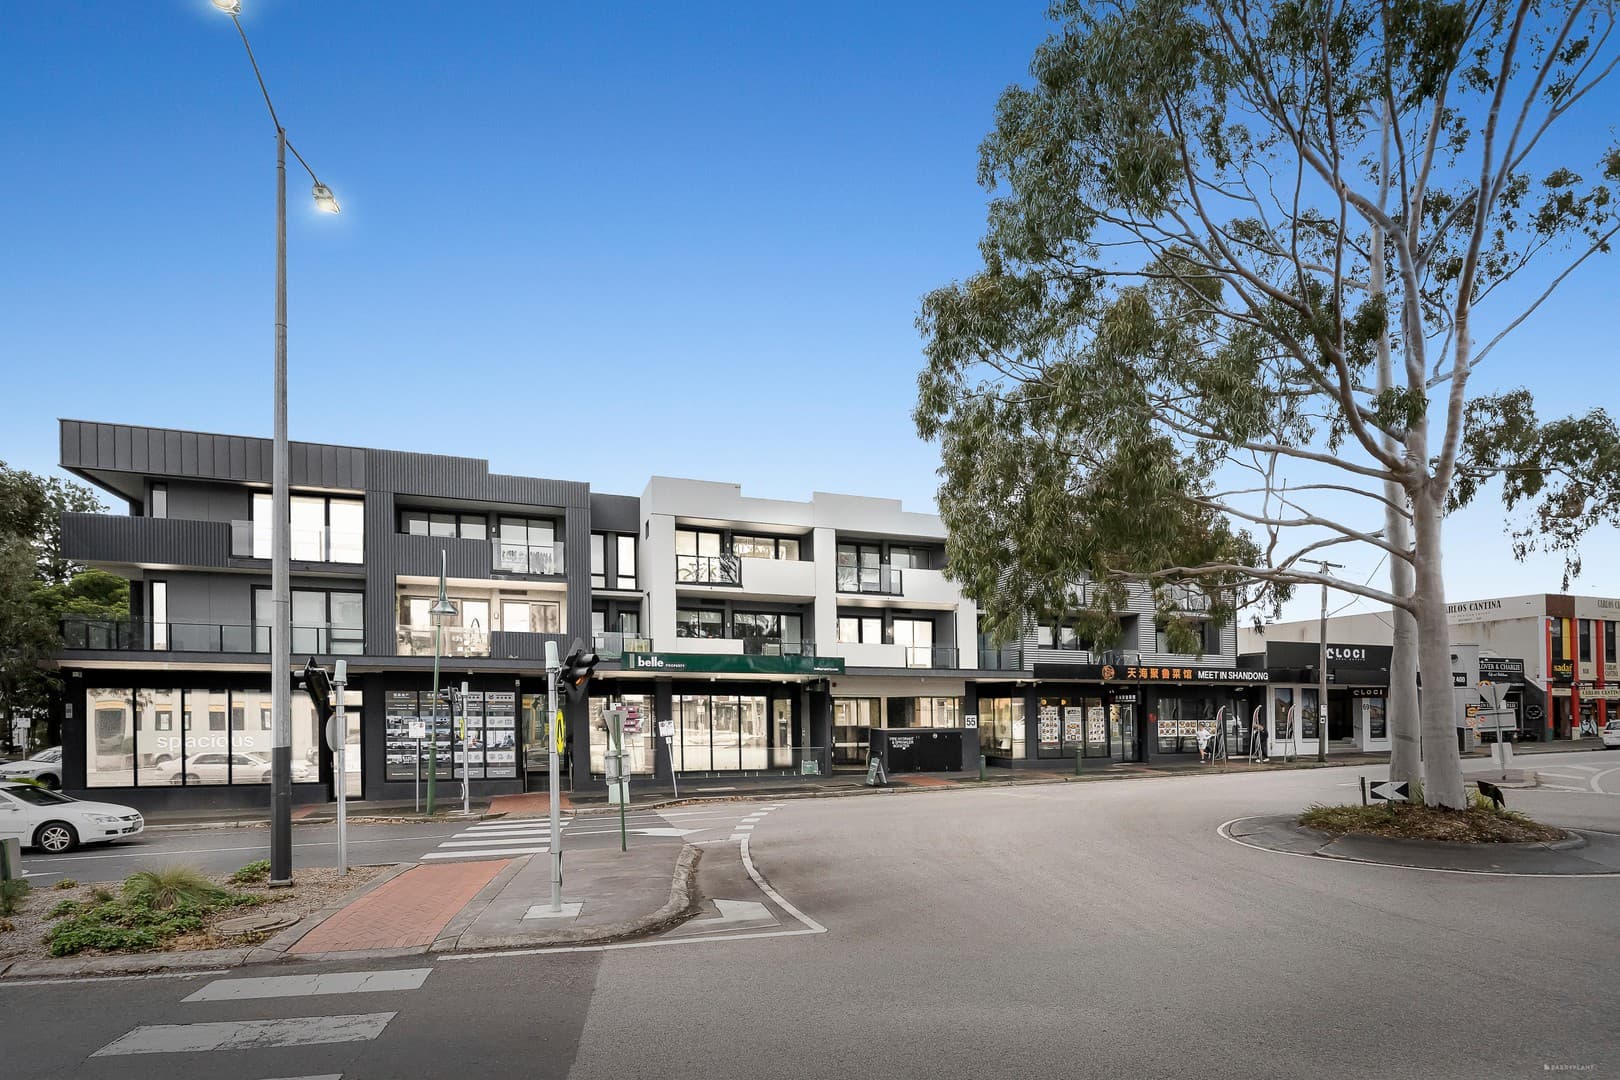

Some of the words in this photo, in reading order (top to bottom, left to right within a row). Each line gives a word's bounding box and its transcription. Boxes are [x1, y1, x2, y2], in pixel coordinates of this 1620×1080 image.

[1469, 600, 1501, 611] CANTINA
[1326, 648, 1366, 659] CLOCI
[638, 656, 663, 667] belle
[1197, 670, 1218, 680] MEET
[1219, 671, 1228, 680] IN
[1228, 671, 1269, 680] SHANDONG
[966, 717, 976, 726] 55
[157, 734, 254, 752] spacious
